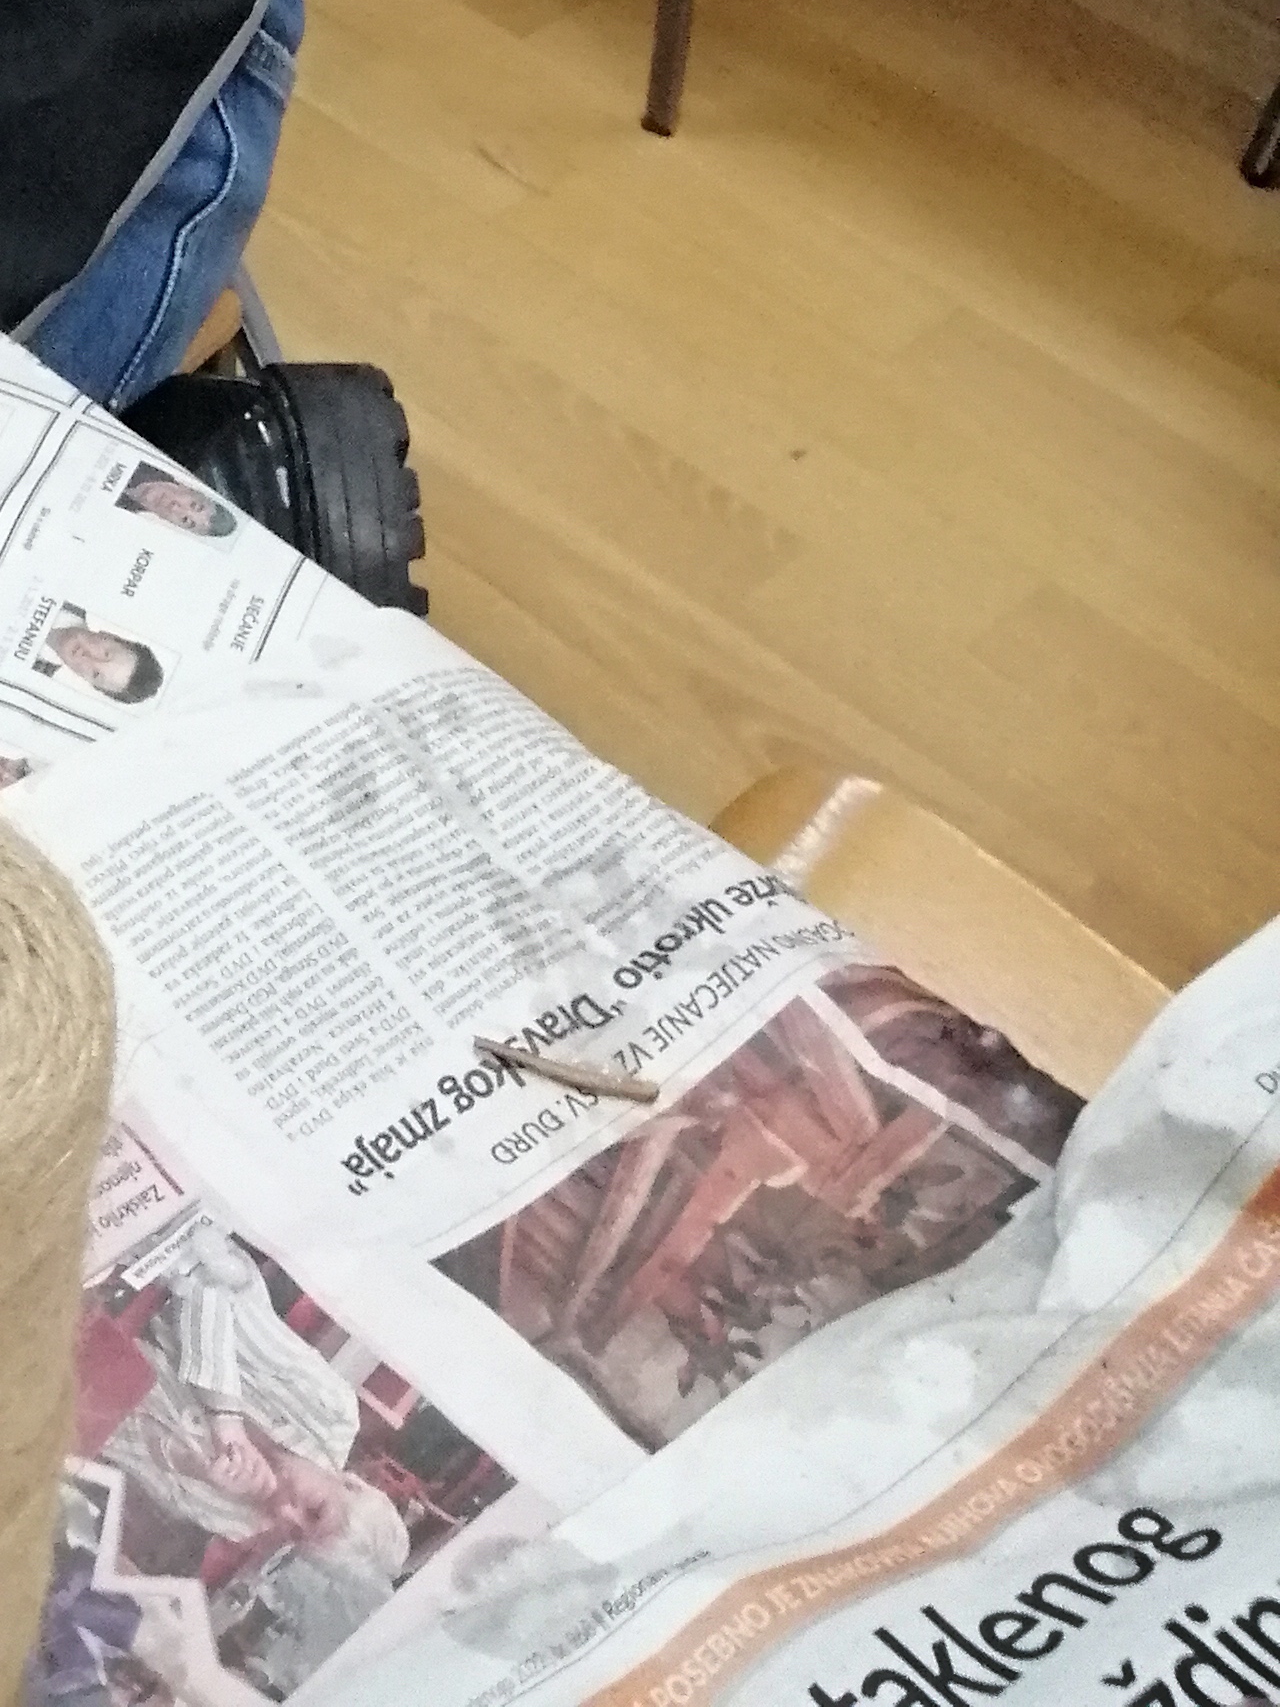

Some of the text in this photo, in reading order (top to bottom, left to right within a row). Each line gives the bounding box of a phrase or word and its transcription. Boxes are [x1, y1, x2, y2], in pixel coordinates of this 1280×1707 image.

[10, 460, 126, 663] MIRKA ŠTEFANIJU
[118, 547, 154, 599] KORPAR
[608, 891, 735, 998] ukrotio
[487, 936, 780, 1169] NATJECANJE ĐURĐ
